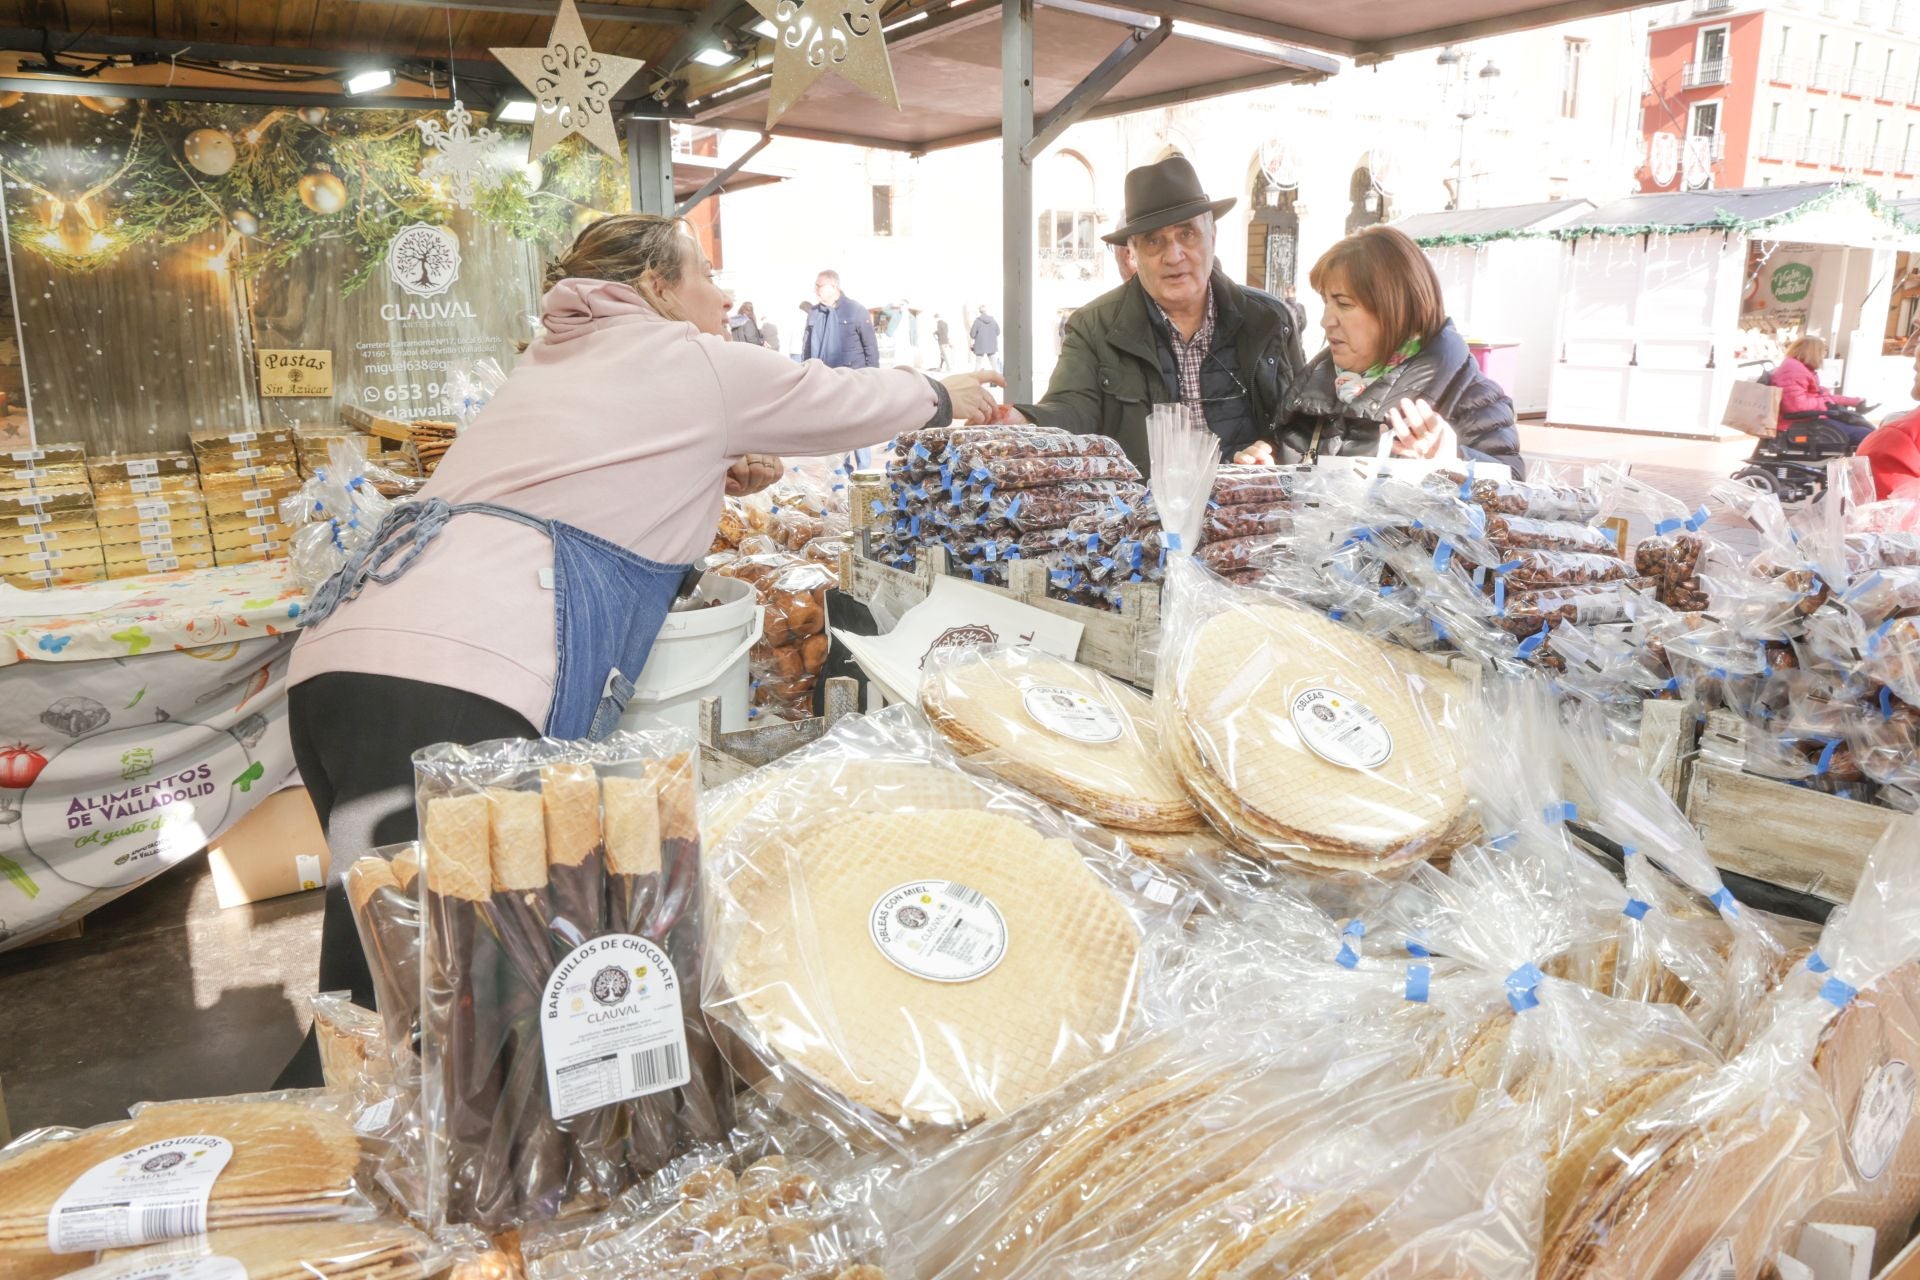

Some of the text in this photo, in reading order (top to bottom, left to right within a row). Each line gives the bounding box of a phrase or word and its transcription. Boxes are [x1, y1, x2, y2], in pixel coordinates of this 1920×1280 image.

[380, 301, 477, 321] CLAUVAL
[264, 353, 326, 370] Pastas
[362, 350, 386, 358] 47160
[263, 384, 284, 395] Sin
[384, 384, 423, 401] 653
[1296, 691, 1325, 712] OBLEAS
[66, 763, 212, 816] ALIMENTOS
[67, 813, 93, 830] DE
[99, 782, 215, 821] VALLADOLID
[100, 818, 149, 846] gusto
[878, 885, 930, 943] OBLEAS CON MIEL
[548, 938, 675, 1020] BARQUILLOS DE CHOCOLATE
[587, 1003, 641, 1025] CLAUVAL
[122, 1136, 223, 1161] BARQUILLOS
